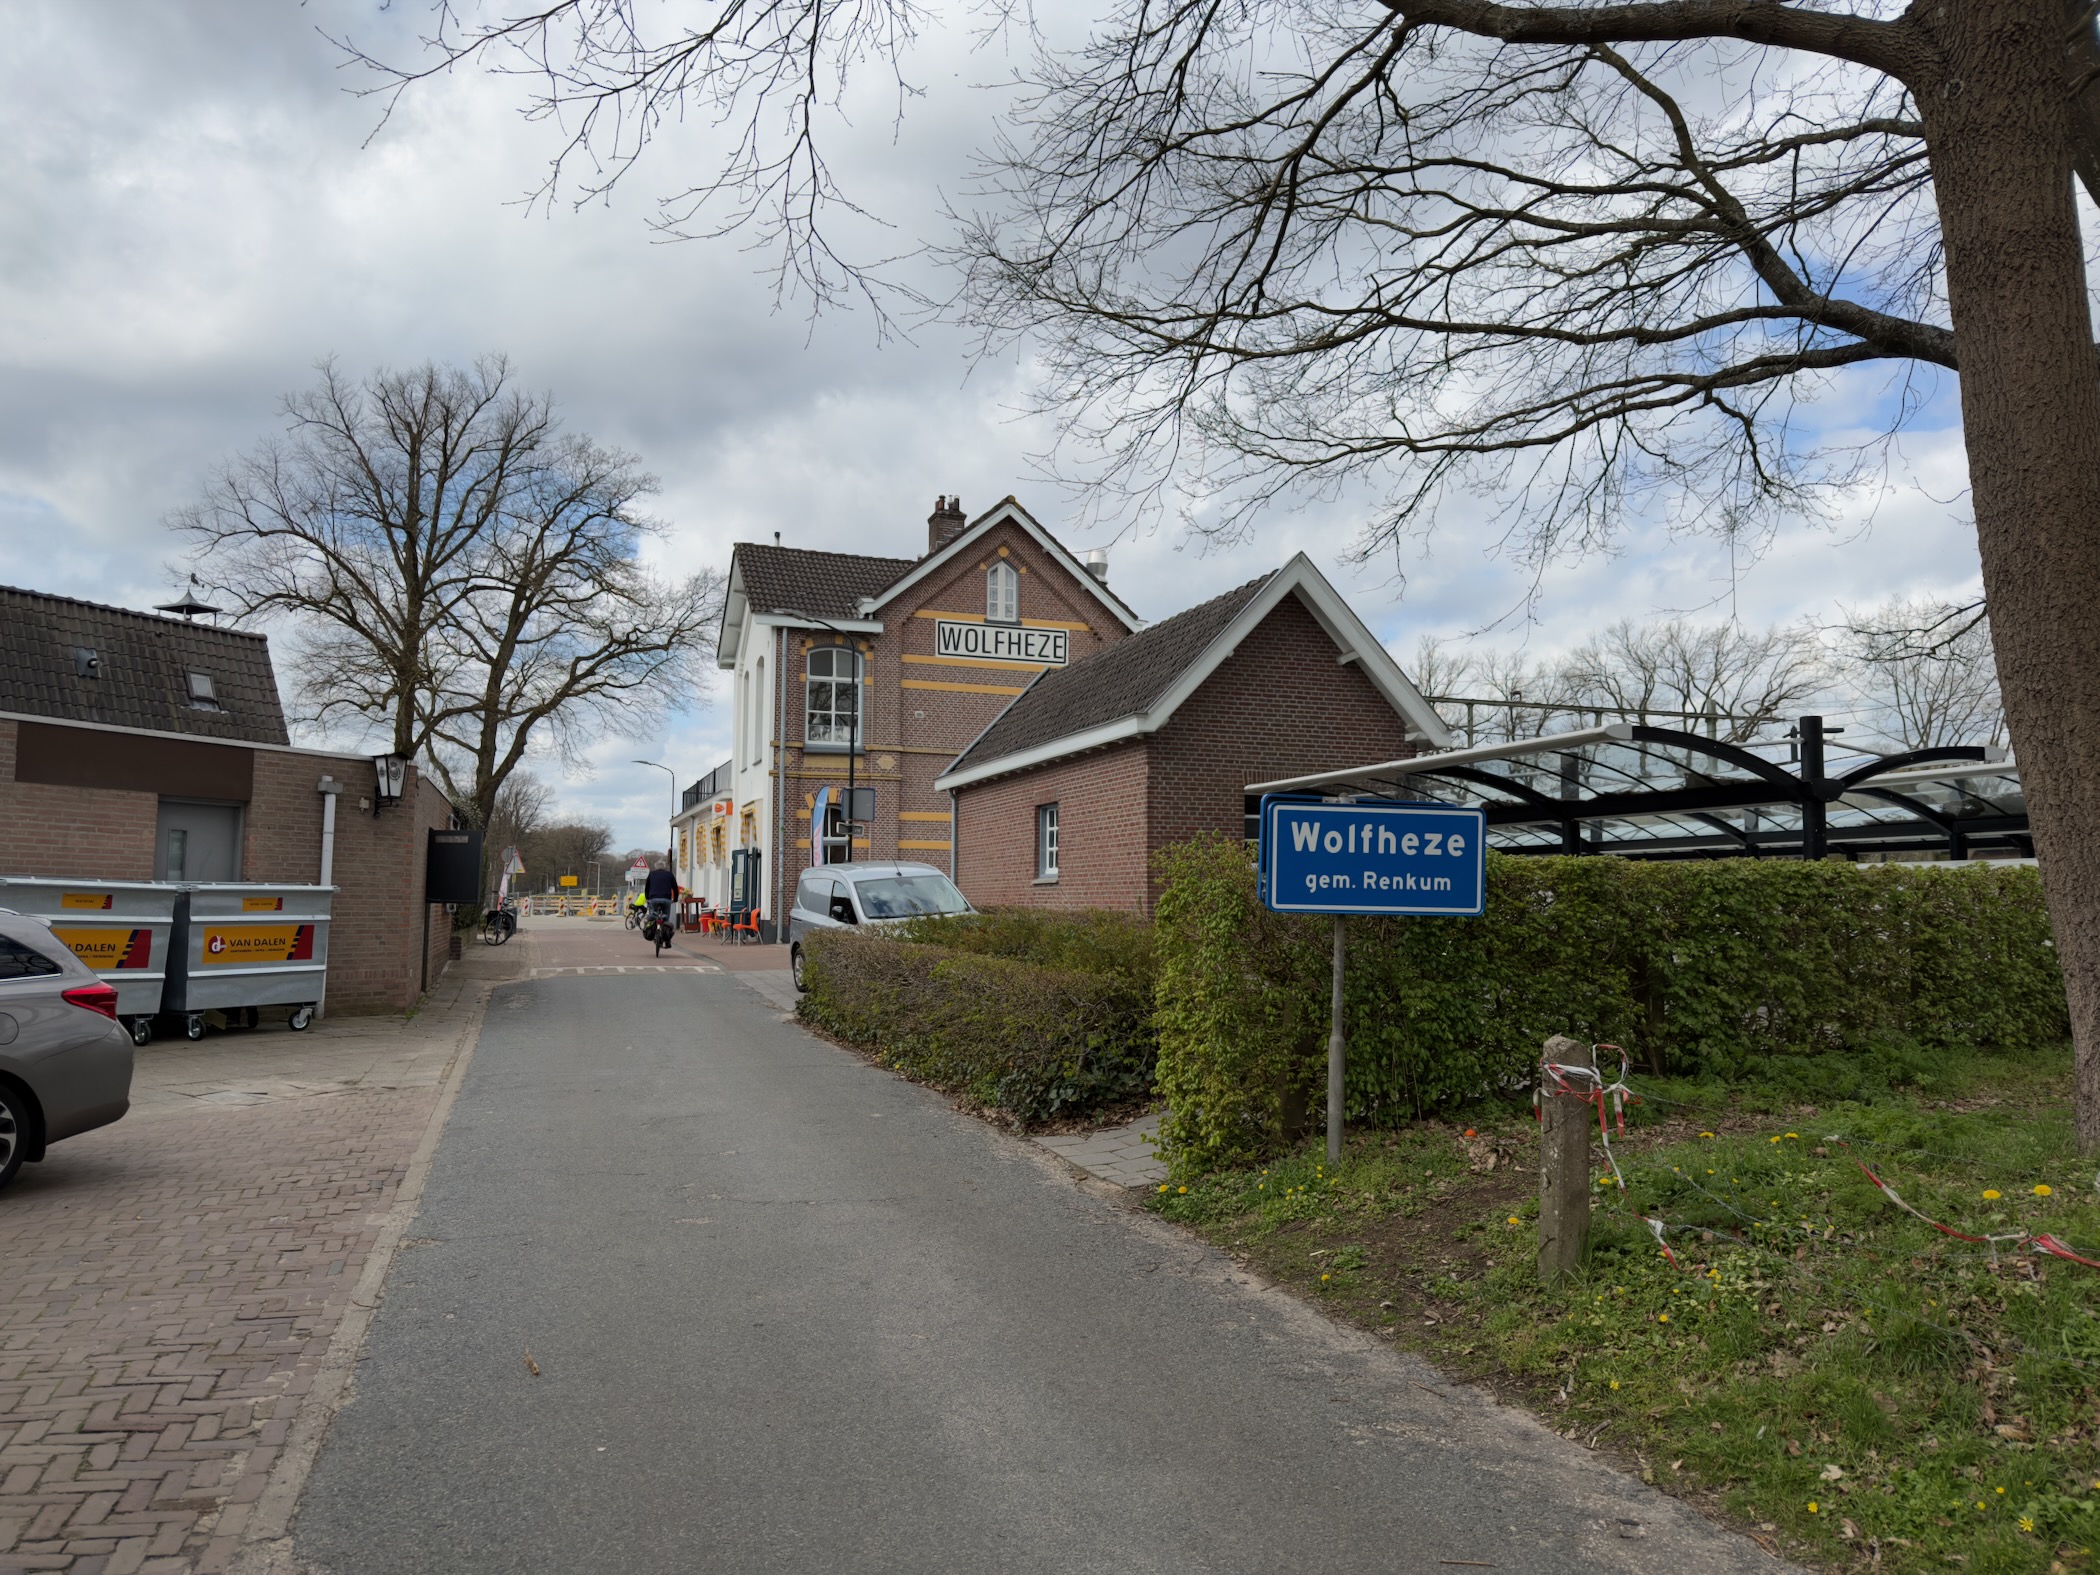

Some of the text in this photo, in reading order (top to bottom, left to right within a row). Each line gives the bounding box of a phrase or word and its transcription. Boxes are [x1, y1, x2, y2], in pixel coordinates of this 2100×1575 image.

[941, 626, 1064, 659] WOLFHEZE
[1291, 821, 1466, 857] Wolfheze
[1305, 871, 1451, 894] gem. Renkum
[75, 943, 116, 952] DALEN
[229, 938, 286, 947] VAN DALEN
